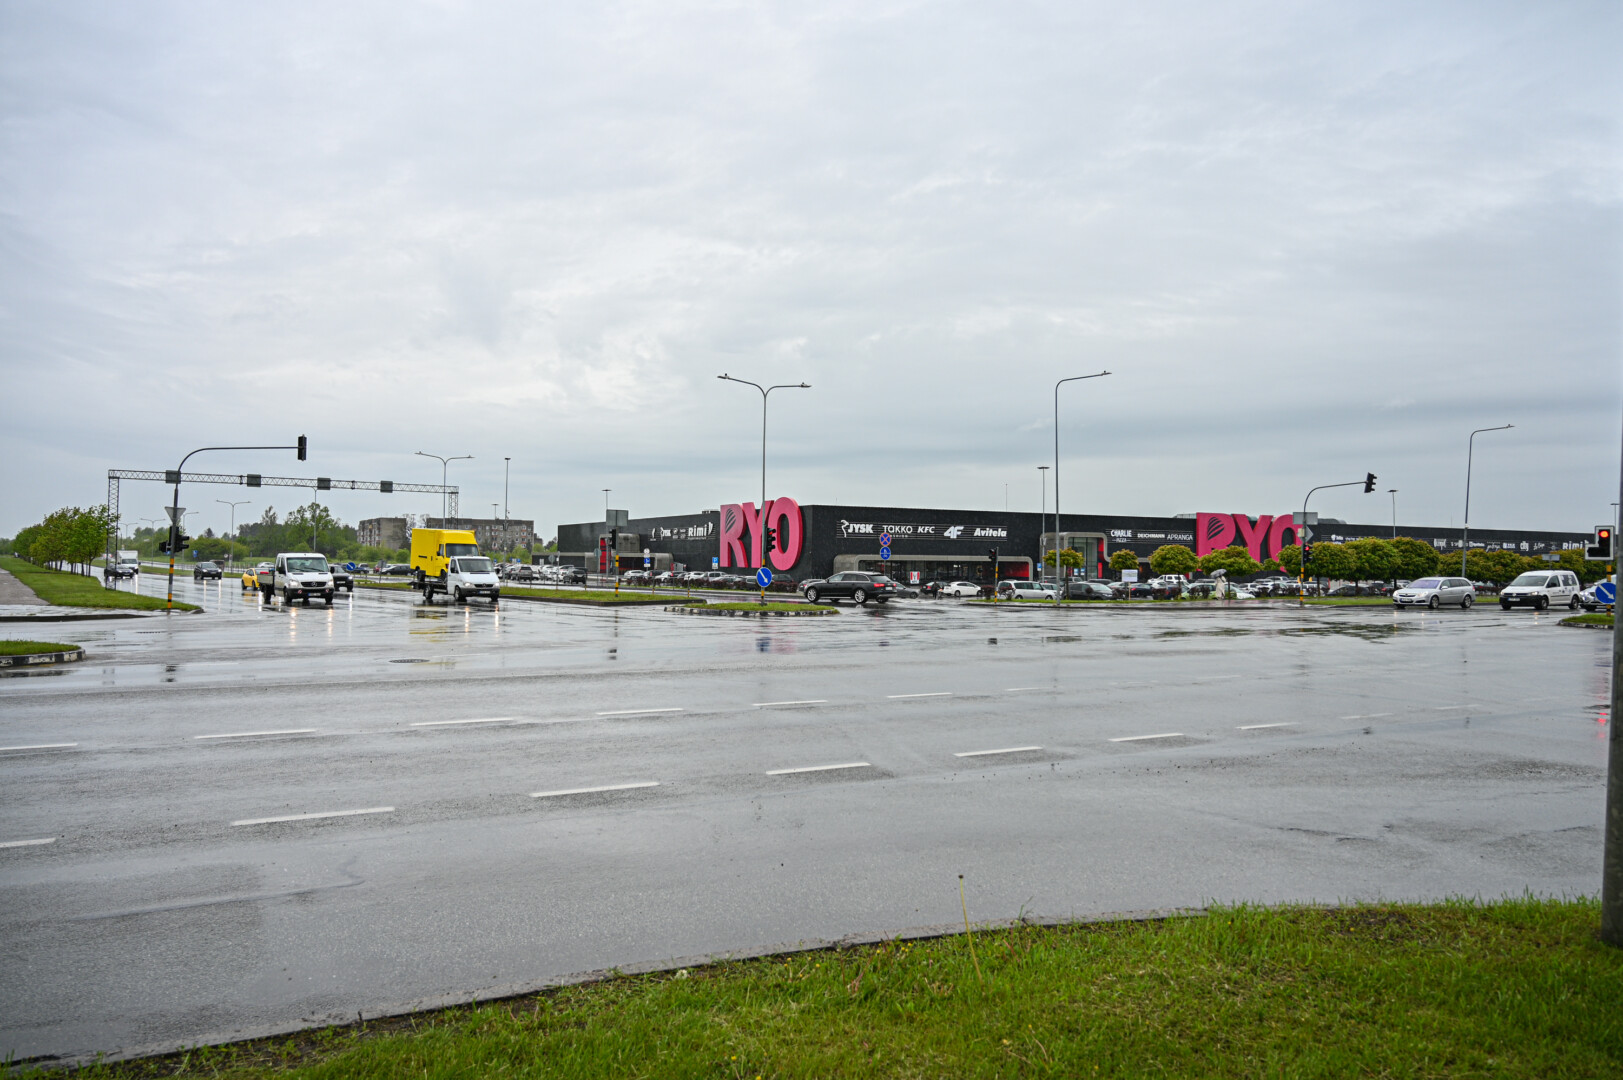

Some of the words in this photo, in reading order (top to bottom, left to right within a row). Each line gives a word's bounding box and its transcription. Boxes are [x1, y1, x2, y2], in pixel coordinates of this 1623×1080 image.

[688, 525, 708, 536] Rimi
[720, 497, 803, 571] RYO
[847, 524, 874, 534] JYSK
[944, 526, 964, 538] 4F
[974, 528, 1007, 536] Avitela
[1562, 541, 1582, 550] Rimi
